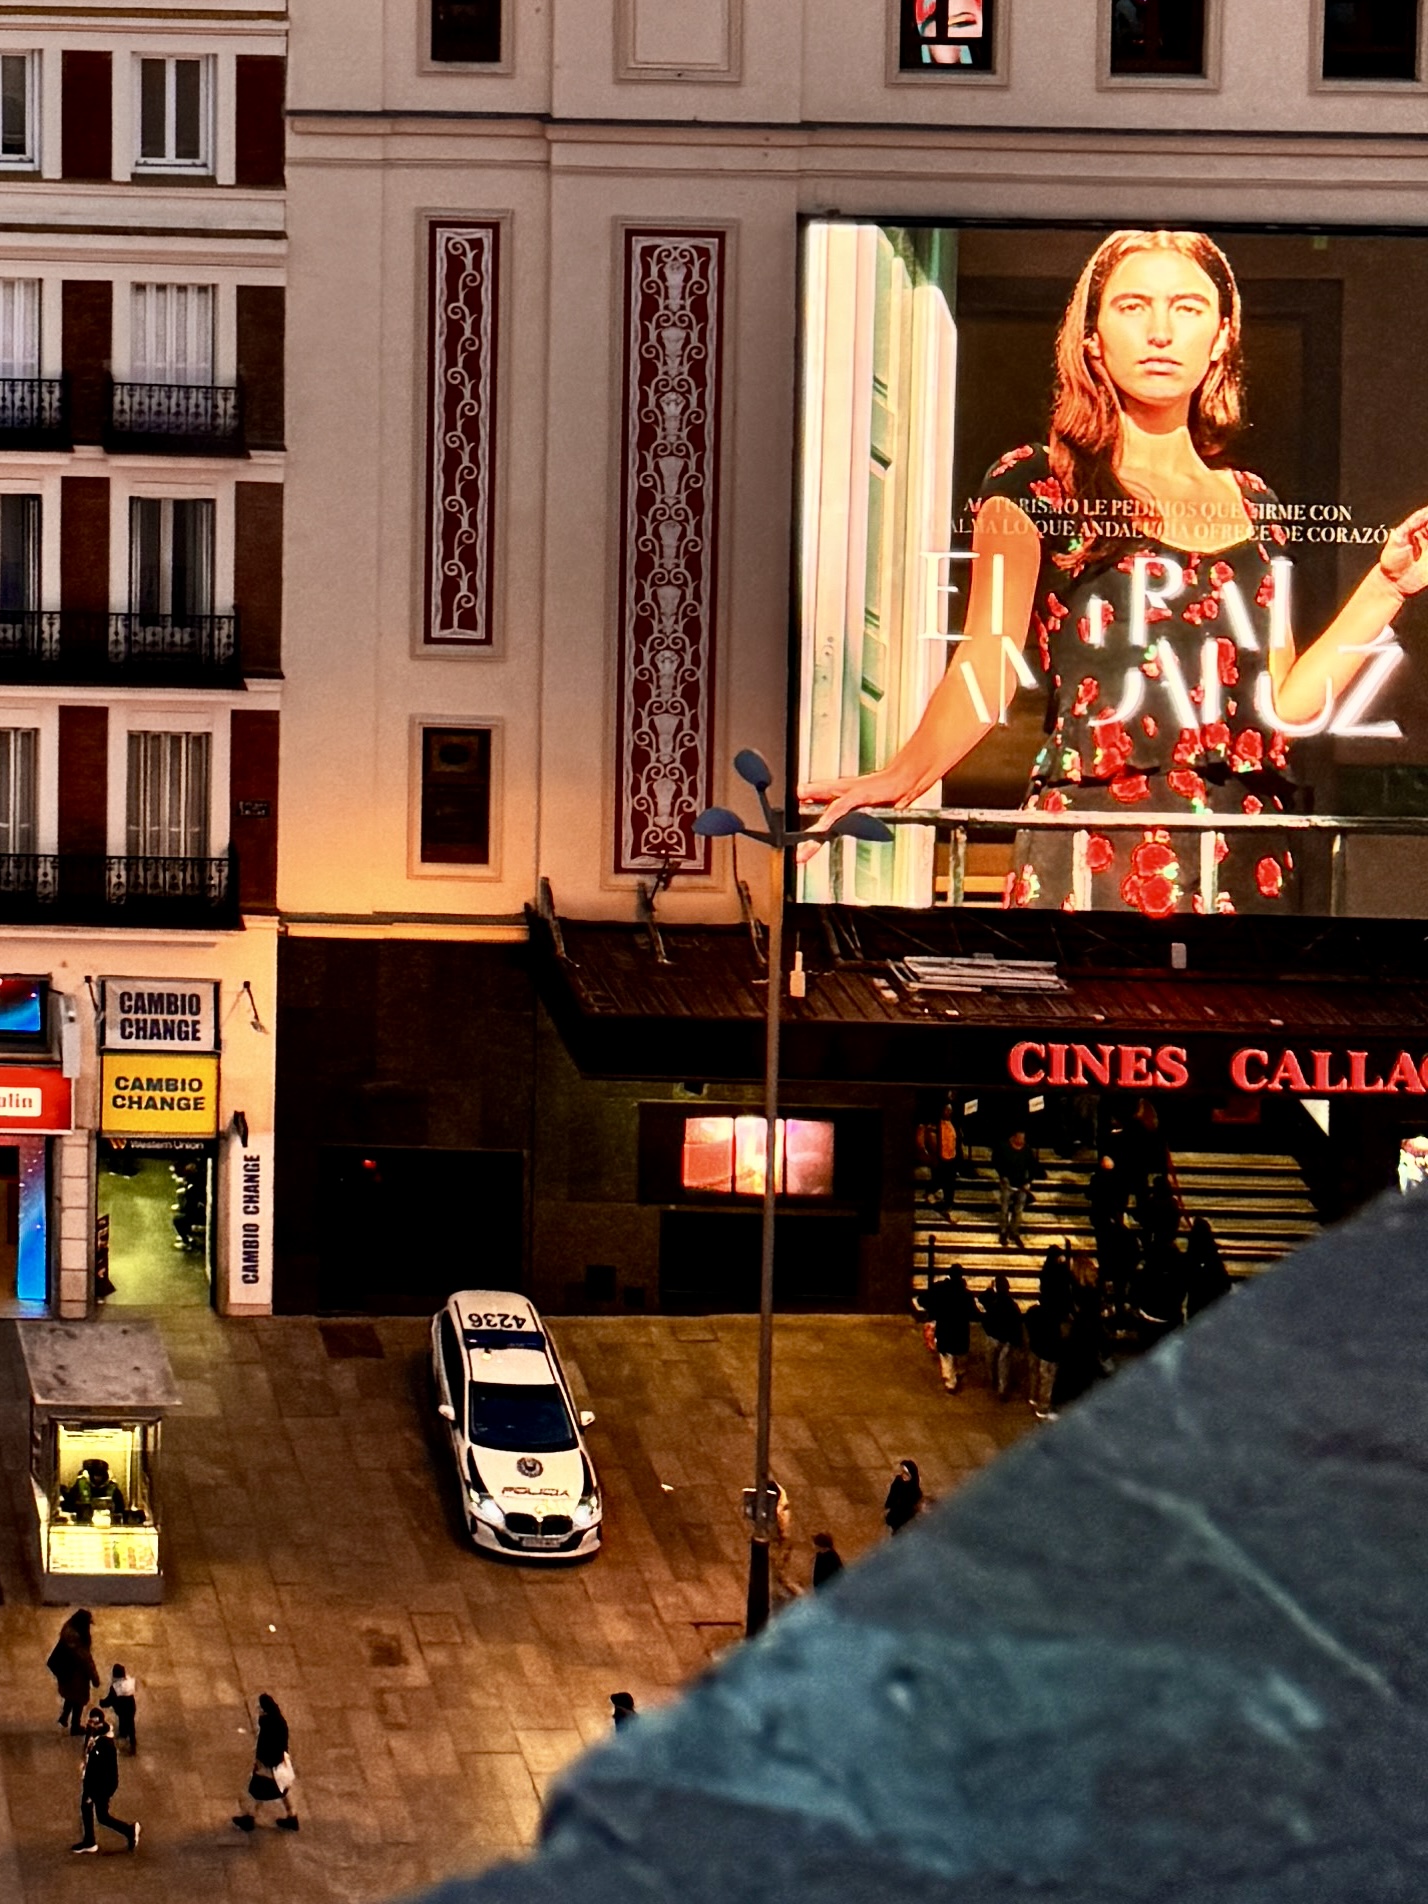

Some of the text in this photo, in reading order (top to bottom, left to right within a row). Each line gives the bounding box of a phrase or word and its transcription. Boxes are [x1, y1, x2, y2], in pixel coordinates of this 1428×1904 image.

[1083, 498, 1107, 516] LE
[1309, 503, 1352, 522] CON
[1034, 519, 1075, 539] QUE
[119, 992, 202, 1017] CAMBIO
[119, 1018, 202, 1042] CHANGE
[1008, 1040, 1190, 1089] CINES
[114, 1075, 204, 1093] CAMBIO
[111, 1094, 206, 1112] CHANGE
[174, 1140, 205, 1151] Union
[241, 1154, 261, 1285] CAMBIO CHANGE
[468, 1311, 527, 1330] 4236
